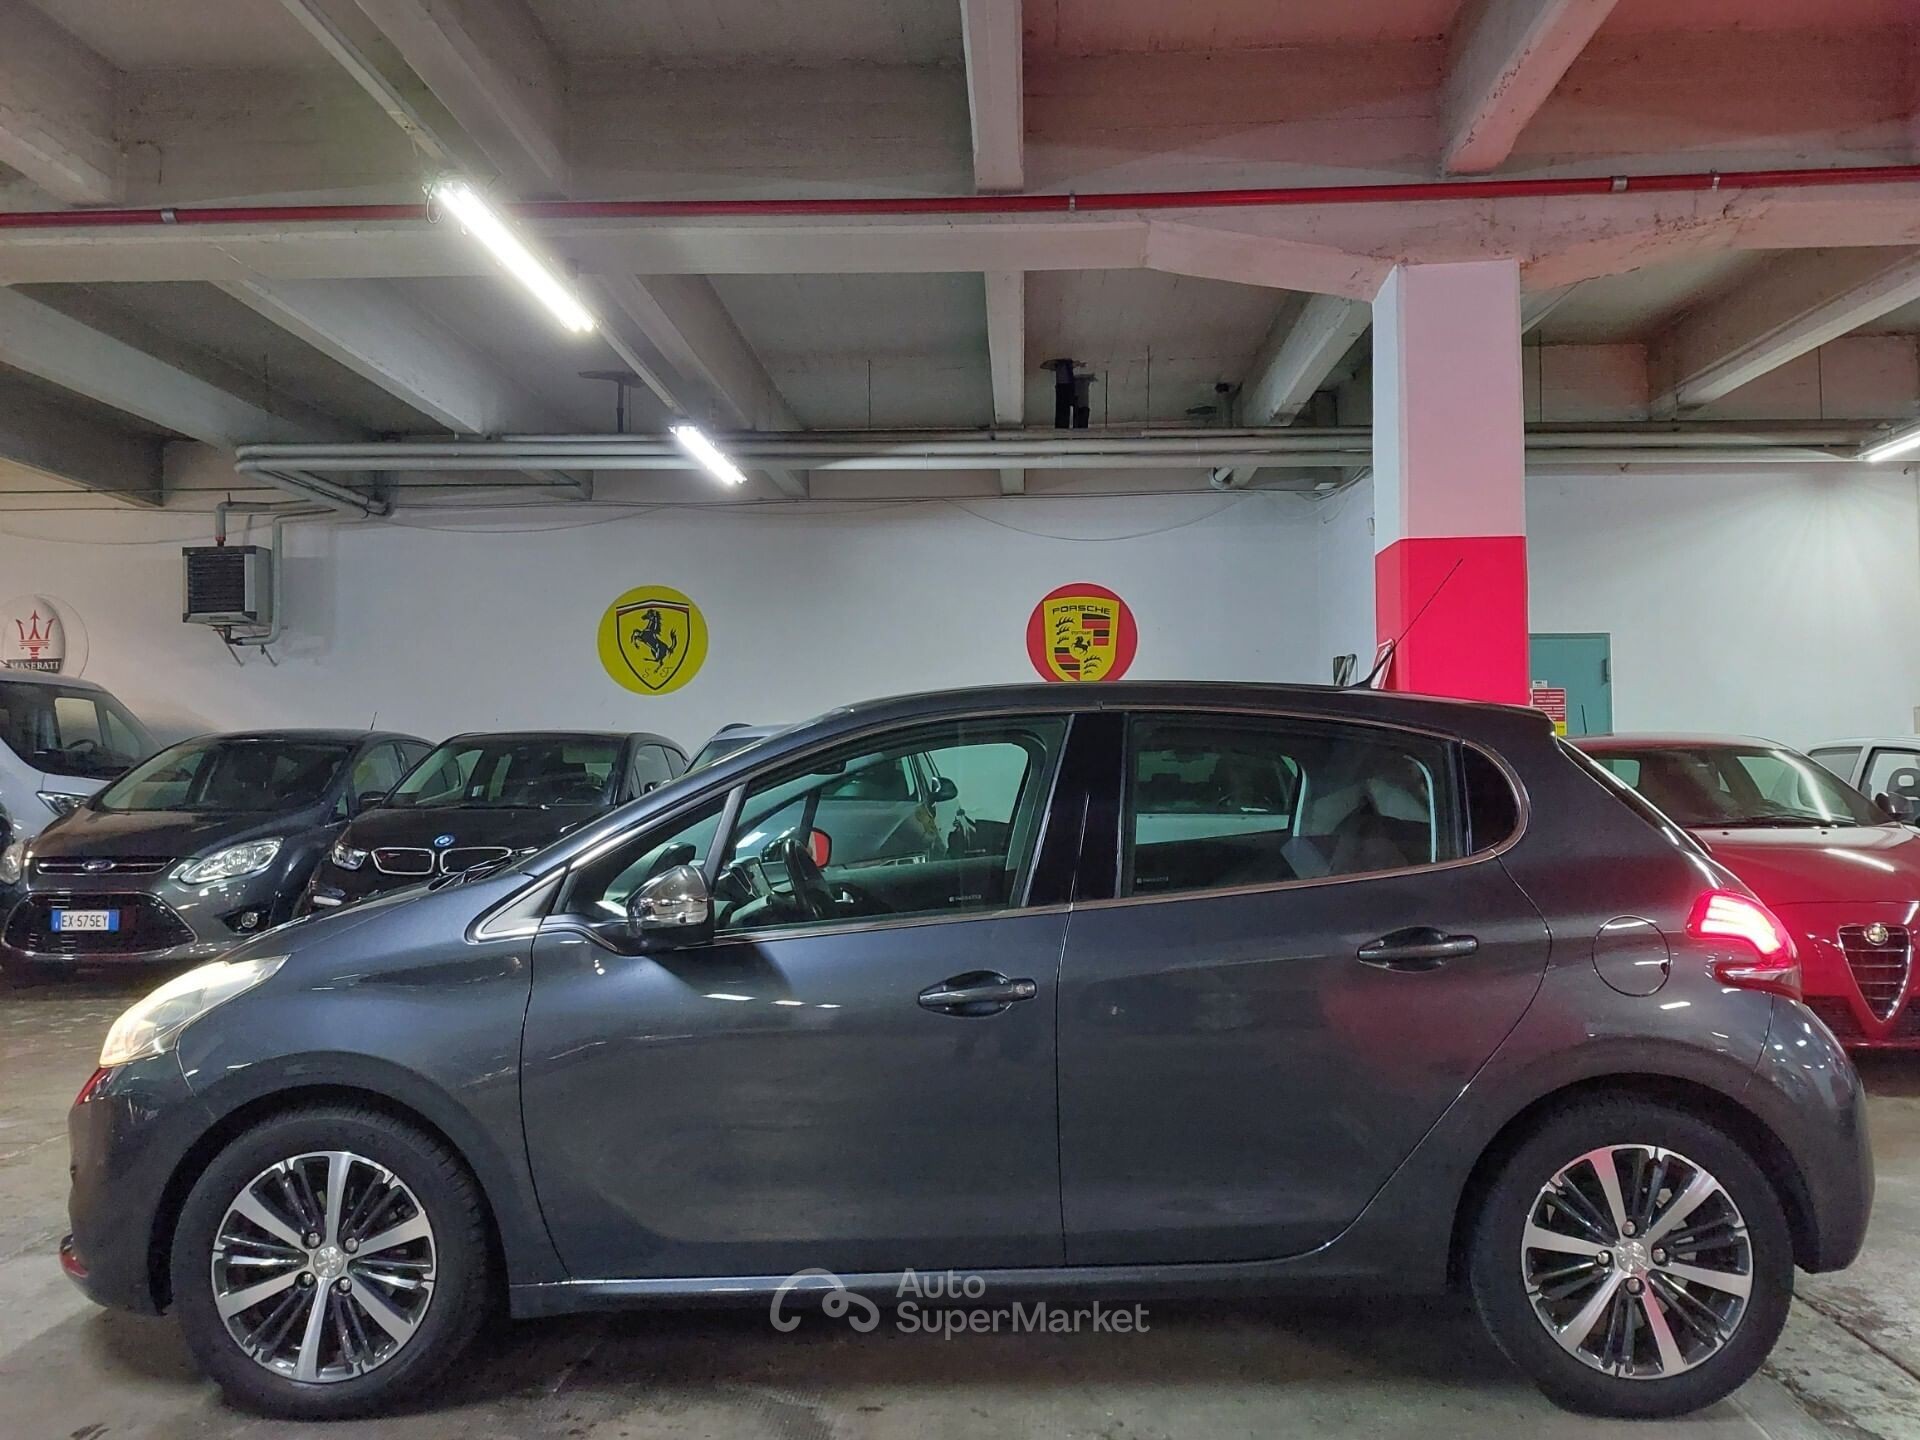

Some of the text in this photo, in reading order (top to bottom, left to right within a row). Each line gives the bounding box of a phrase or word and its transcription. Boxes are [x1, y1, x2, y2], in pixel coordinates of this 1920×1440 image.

[1052, 605, 1111, 615] PORSCHE
[10, 661, 59, 670] MASERATI
[61, 915, 73, 927] EX
